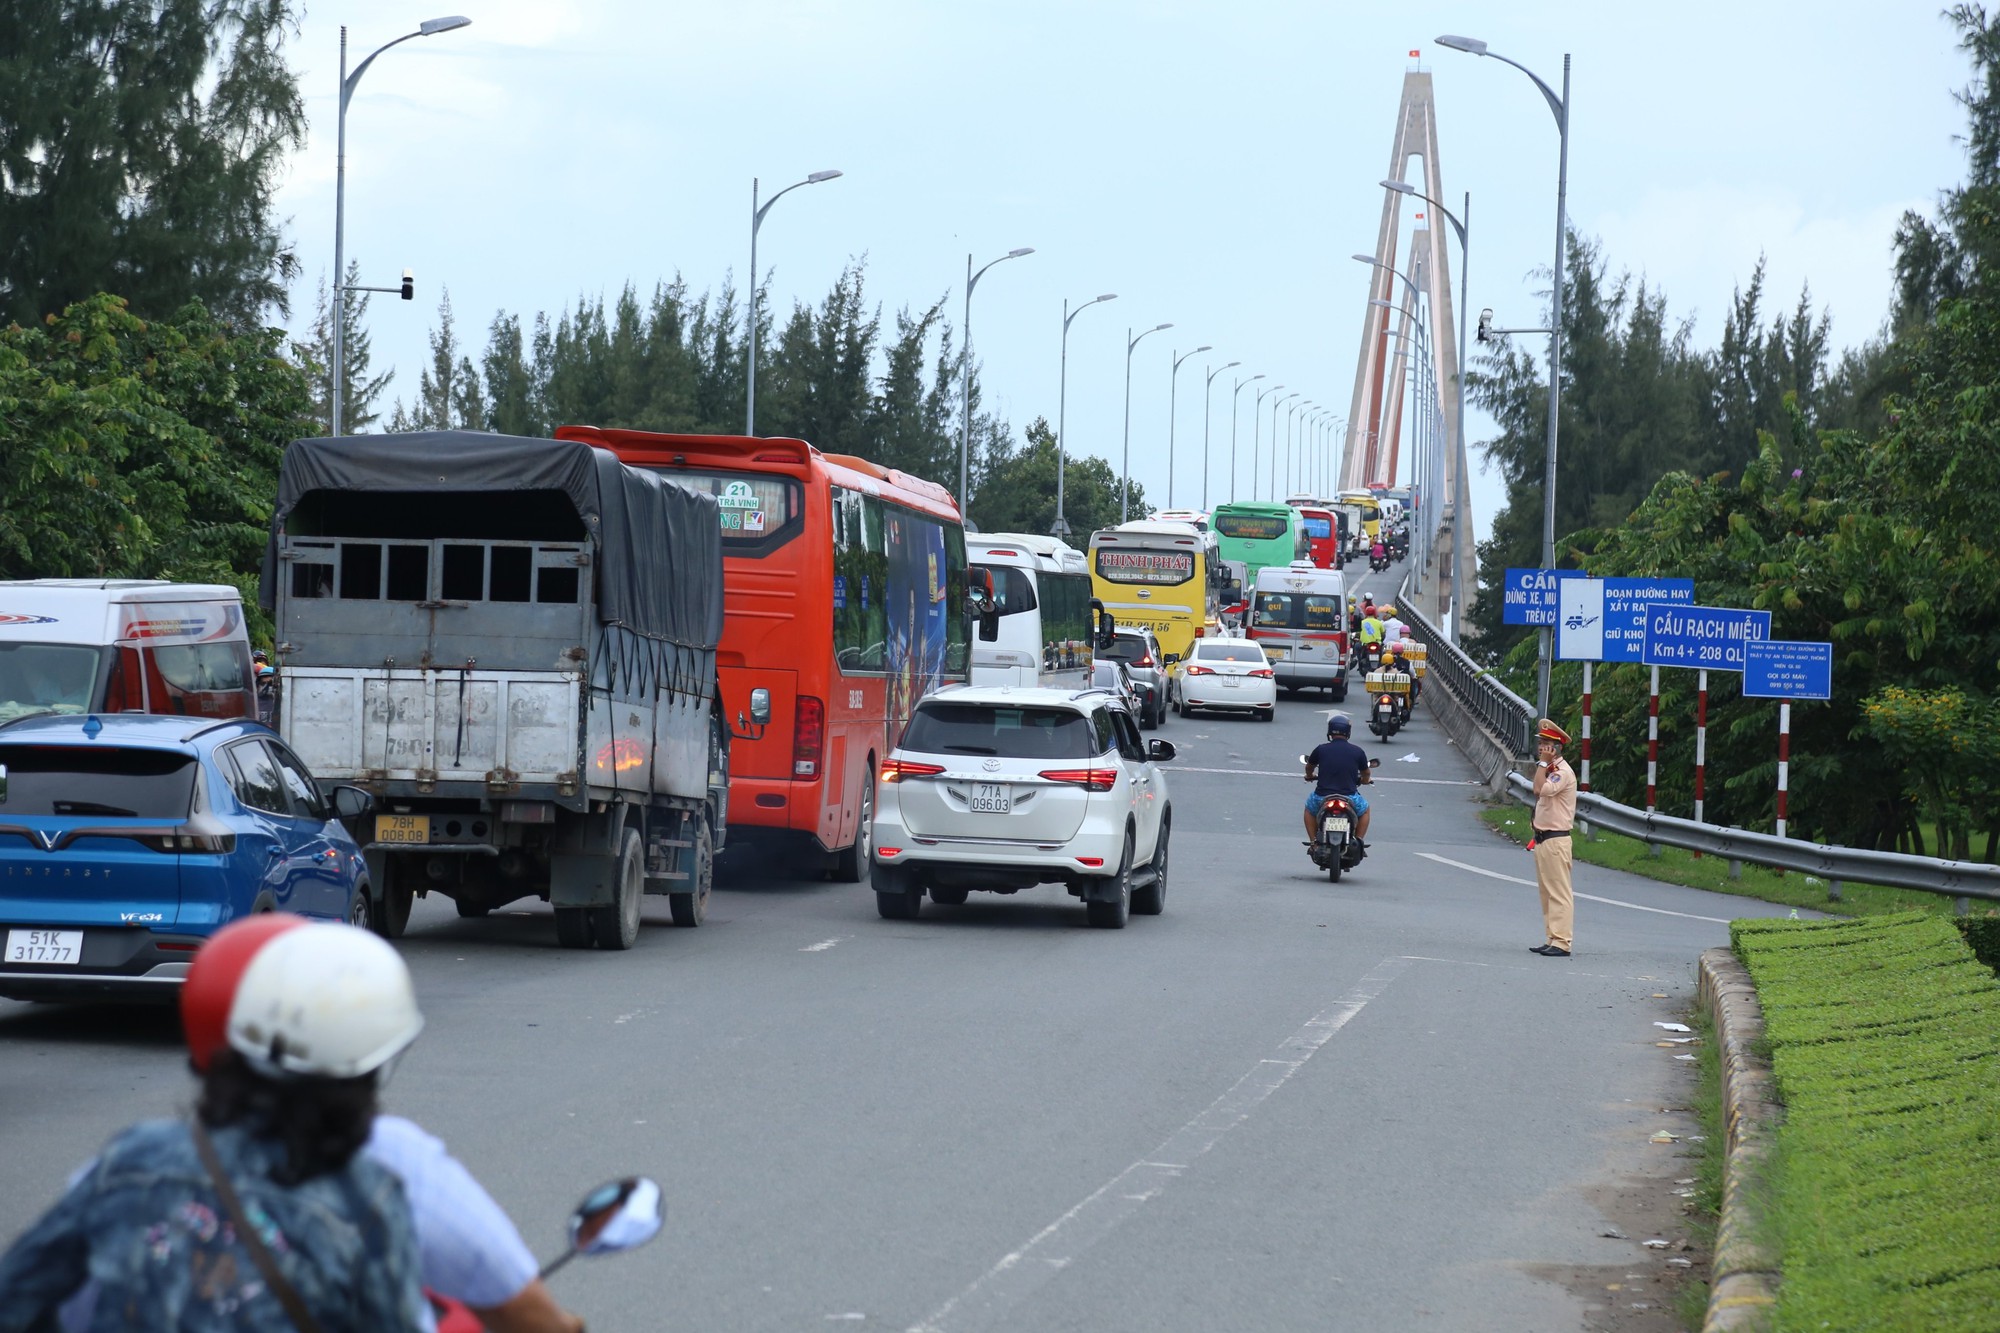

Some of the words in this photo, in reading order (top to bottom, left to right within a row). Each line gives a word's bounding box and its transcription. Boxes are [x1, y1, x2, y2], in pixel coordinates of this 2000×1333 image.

[731, 485, 746, 496] 21
[738, 499, 758, 508] VINH
[720, 513, 741, 529] NG
[1100, 553, 1148, 570] THỊNH
[1152, 553, 1191, 570] PHÁT
[1505, 588, 1526, 604] DỪNG
[1544, 592, 1556, 605] MU
[1606, 589, 1632, 600] ĐOẠN
[1635, 586, 1667, 598] ĐƯỜNG
[1671, 590, 1690, 598] HAY
[1610, 599, 1629, 612] XẢY
[1632, 603, 1645, 612] RA
[1525, 608, 1546, 624] TRÊN
[1633, 616, 1646, 626] CH
[1654, 611, 1682, 636] CẦU
[1686, 618, 1724, 640] RẠCH
[1728, 615, 1762, 640] MIỄU
[1605, 627, 1621, 639] GIỮ
[1626, 644, 1640, 652] AN
[1654, 642, 1674, 657] Km
[1700, 646, 1722, 660] 208
[982, 785, 1000, 798] 71A
[972, 798, 1008, 811] 096.03
[392, 817, 415, 829] 78H
[382, 830, 423, 842] 008.08
[139, 913, 162, 921] e34
[30, 932, 60, 946] 51K
[15, 946, 71, 961] 317.77
